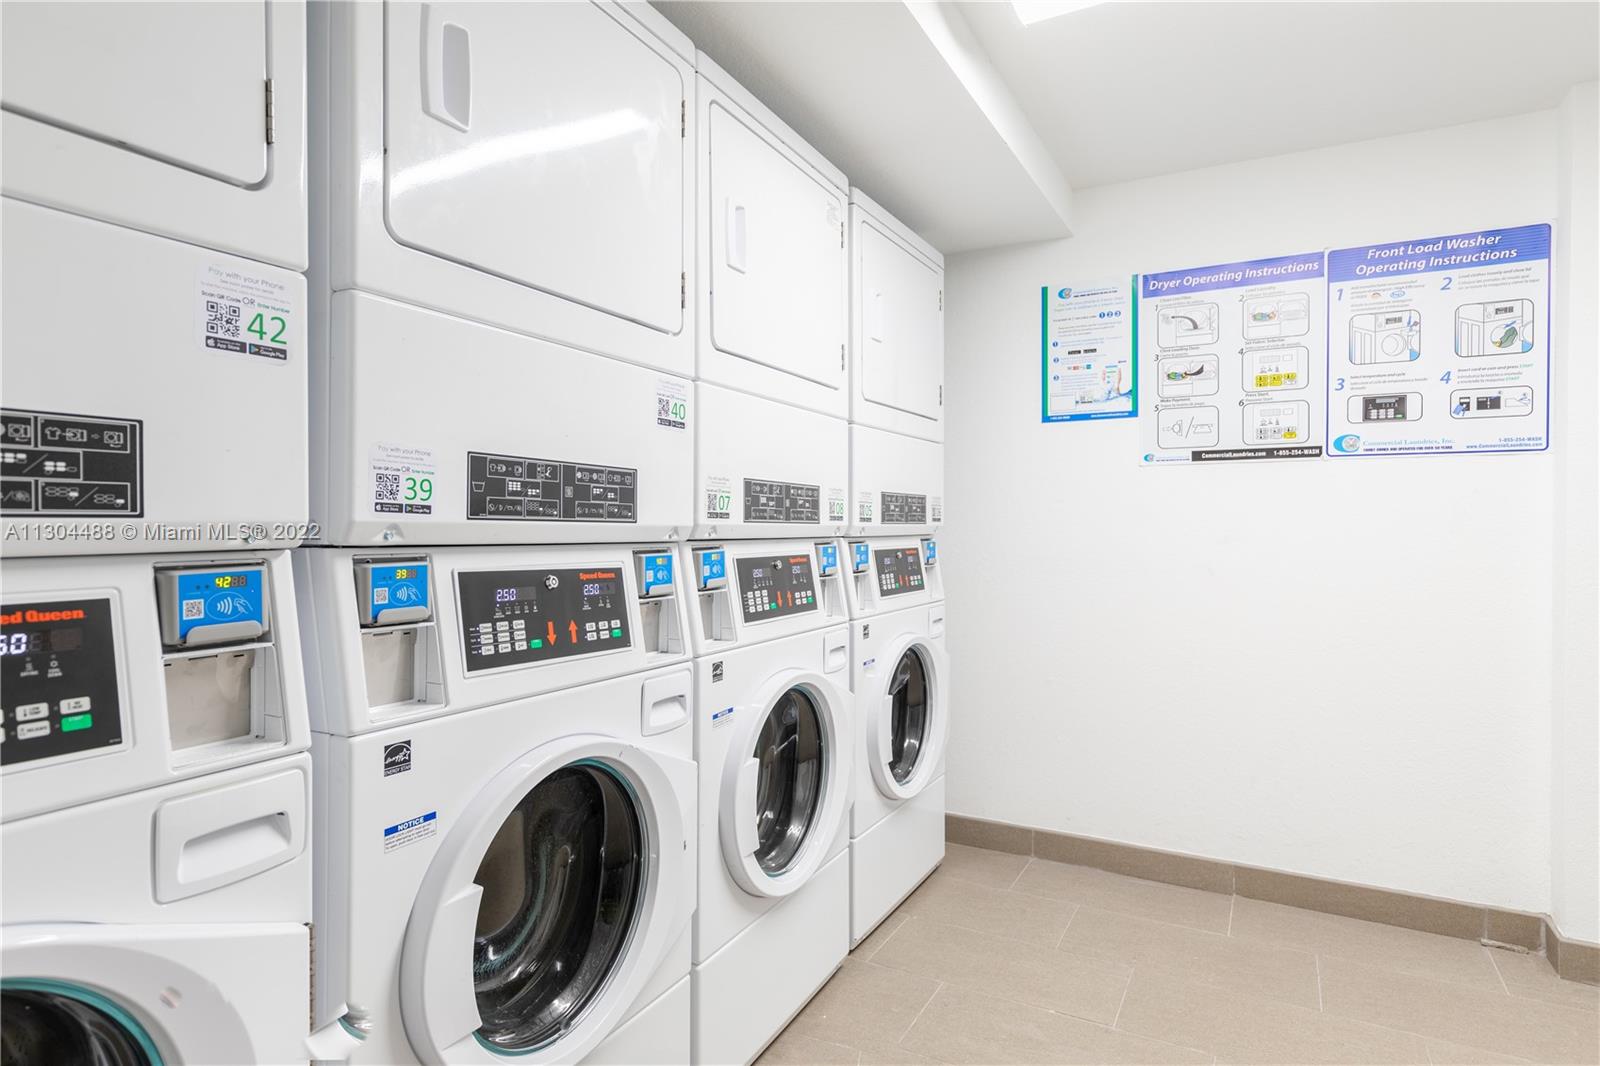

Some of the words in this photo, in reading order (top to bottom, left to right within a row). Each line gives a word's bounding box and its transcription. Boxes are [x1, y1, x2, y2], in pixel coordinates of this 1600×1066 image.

[1367, 246, 1404, 260] Front
[1408, 240, 1443, 255] Load
[1447, 234, 1502, 250] Washer
[1356, 258, 1426, 276] Operating
[1429, 248, 1518, 268] Instructions
[225, 271, 242, 280] with
[244, 276, 260, 286] your
[261, 279, 285, 291] Phone
[1149, 278, 1181, 291] Dryer
[1183, 270, 1242, 286] Operating
[1245, 261, 1319, 278] Instructions
[1440, 277, 1453, 291] 2
[201, 290, 216, 298] Scan
[242, 296, 255, 305] OR
[1336, 288, 1344, 301] 1
[247, 313, 287, 345] 42
[1335, 378, 1345, 391] 3
[1440, 370, 1452, 384] 4
[671, 402, 686, 420] 40
[404, 477, 432, 501] 39
[718, 495, 731, 511] 07
[396, 569, 407, 579] 39
[580, 572, 597, 580] Speed
[216, 576, 231, 588] 42
[25, 609, 85, 622] Queen
[398, 816, 424, 831] NOTICE
